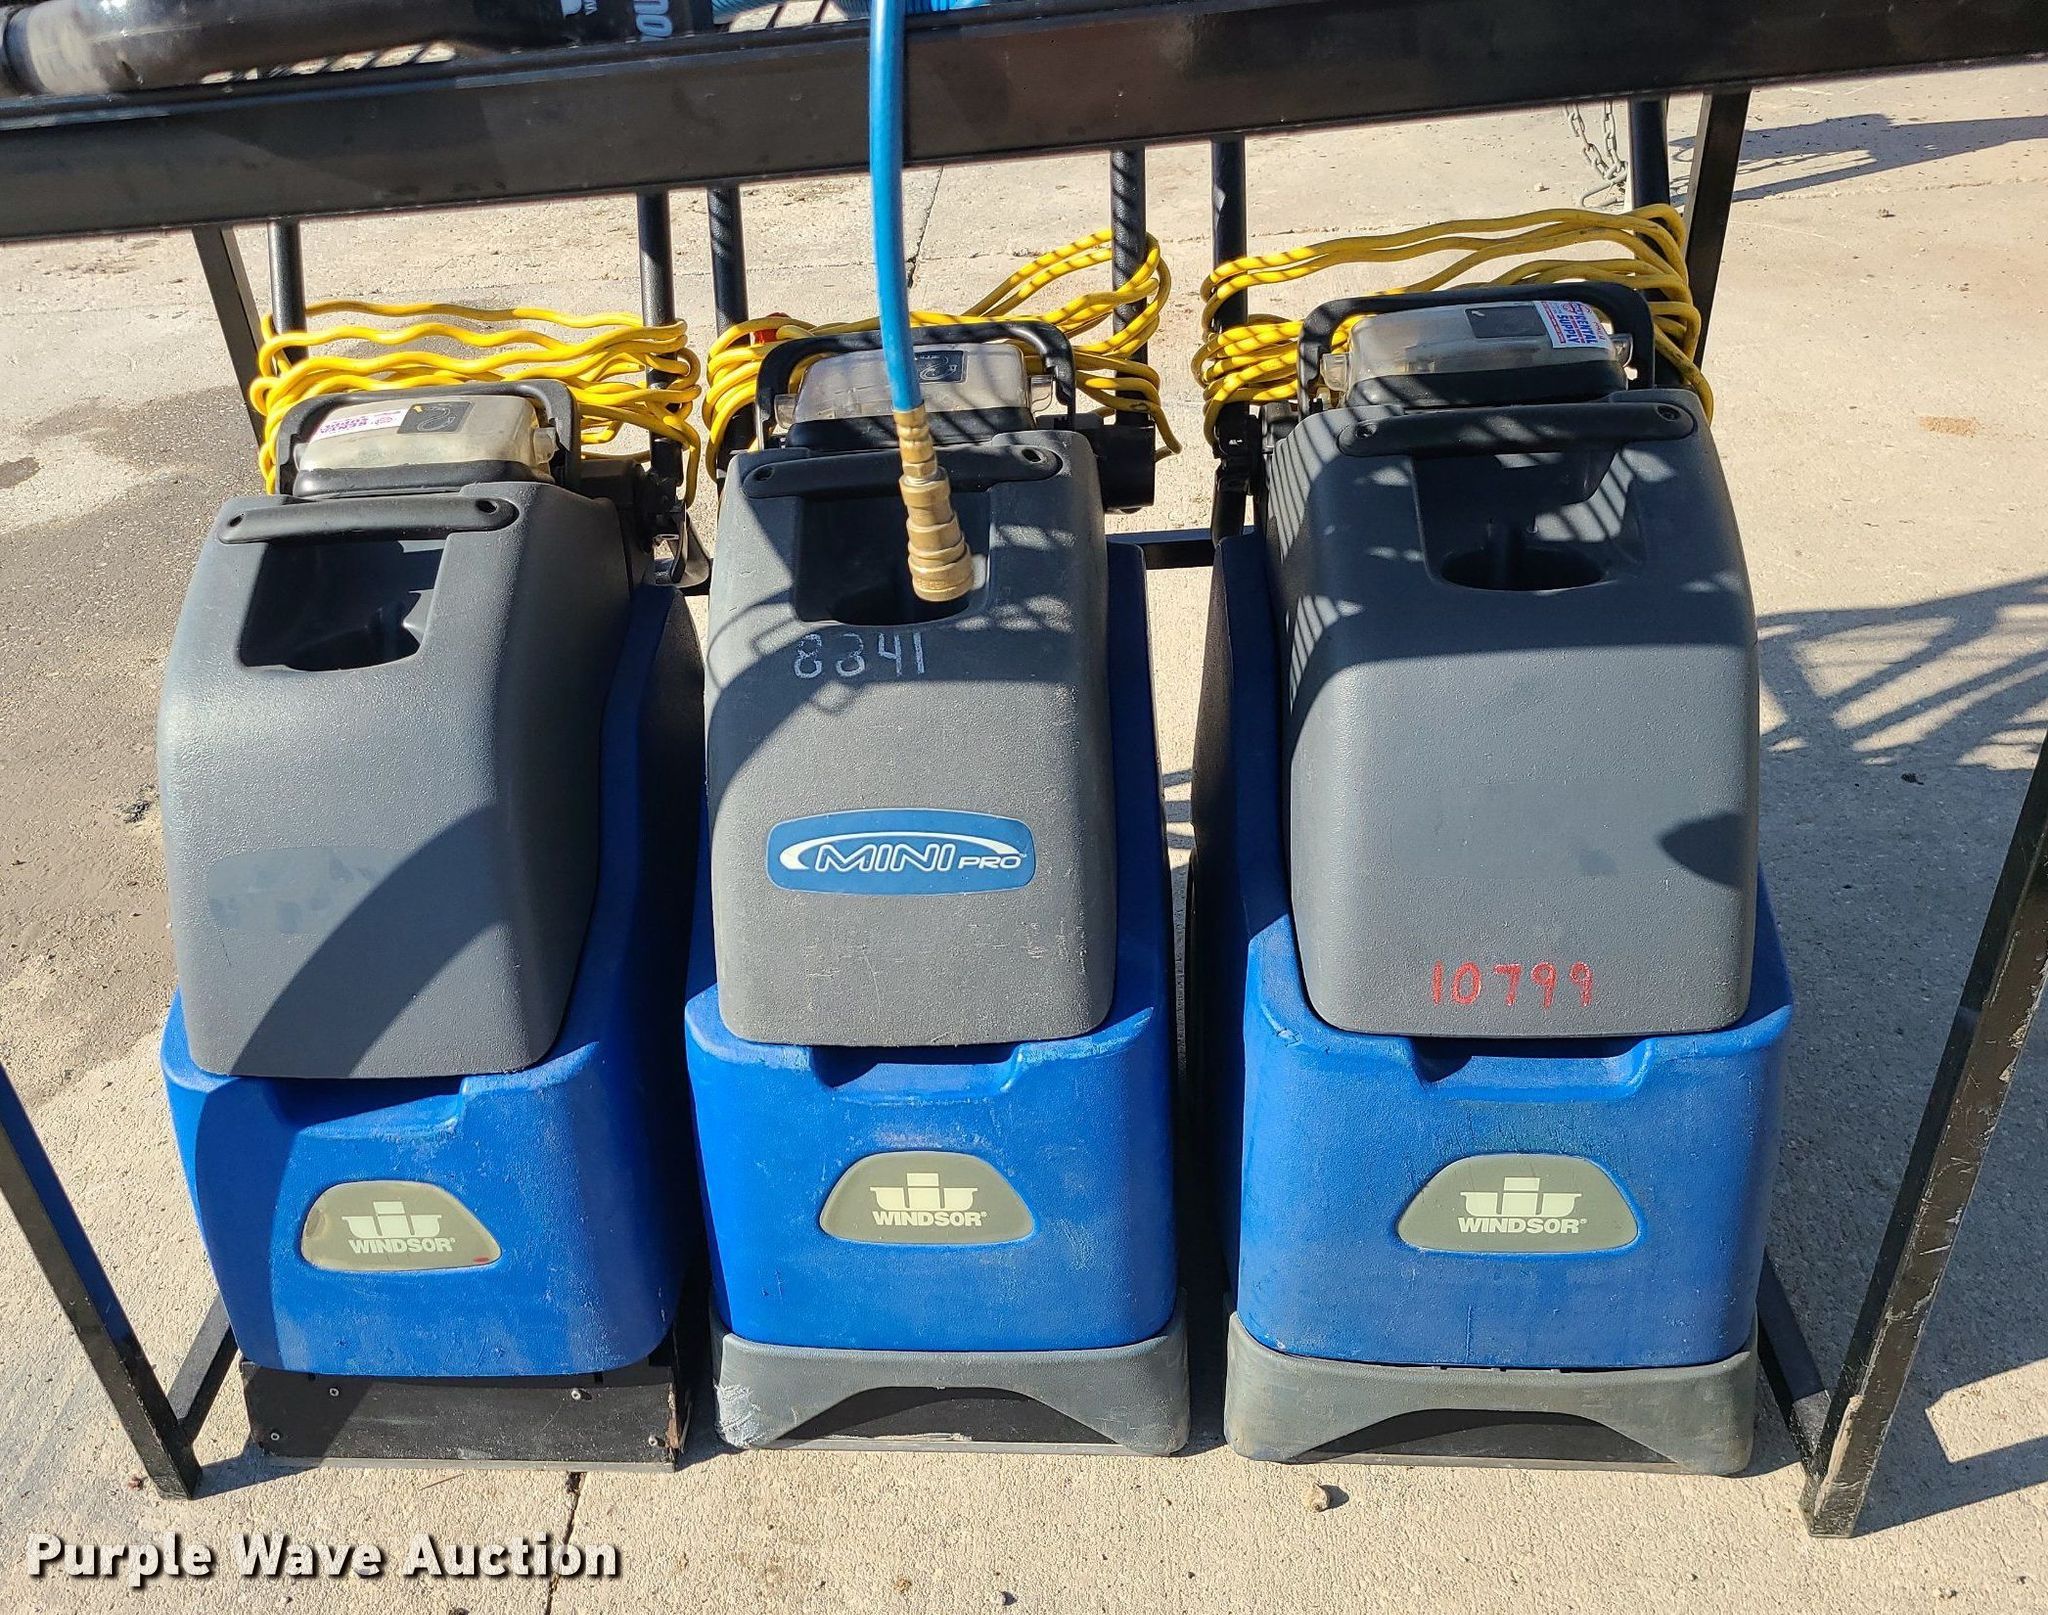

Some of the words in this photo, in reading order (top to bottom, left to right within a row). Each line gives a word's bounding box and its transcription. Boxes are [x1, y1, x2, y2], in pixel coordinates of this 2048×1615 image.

[1557, 315, 1581, 343] SUPPLY
[1574, 315, 1598, 344] RENTAL
[794, 632, 925, 678] 8341
[815, 843, 956, 872] MINI
[1432, 960, 1593, 1008] 10799
